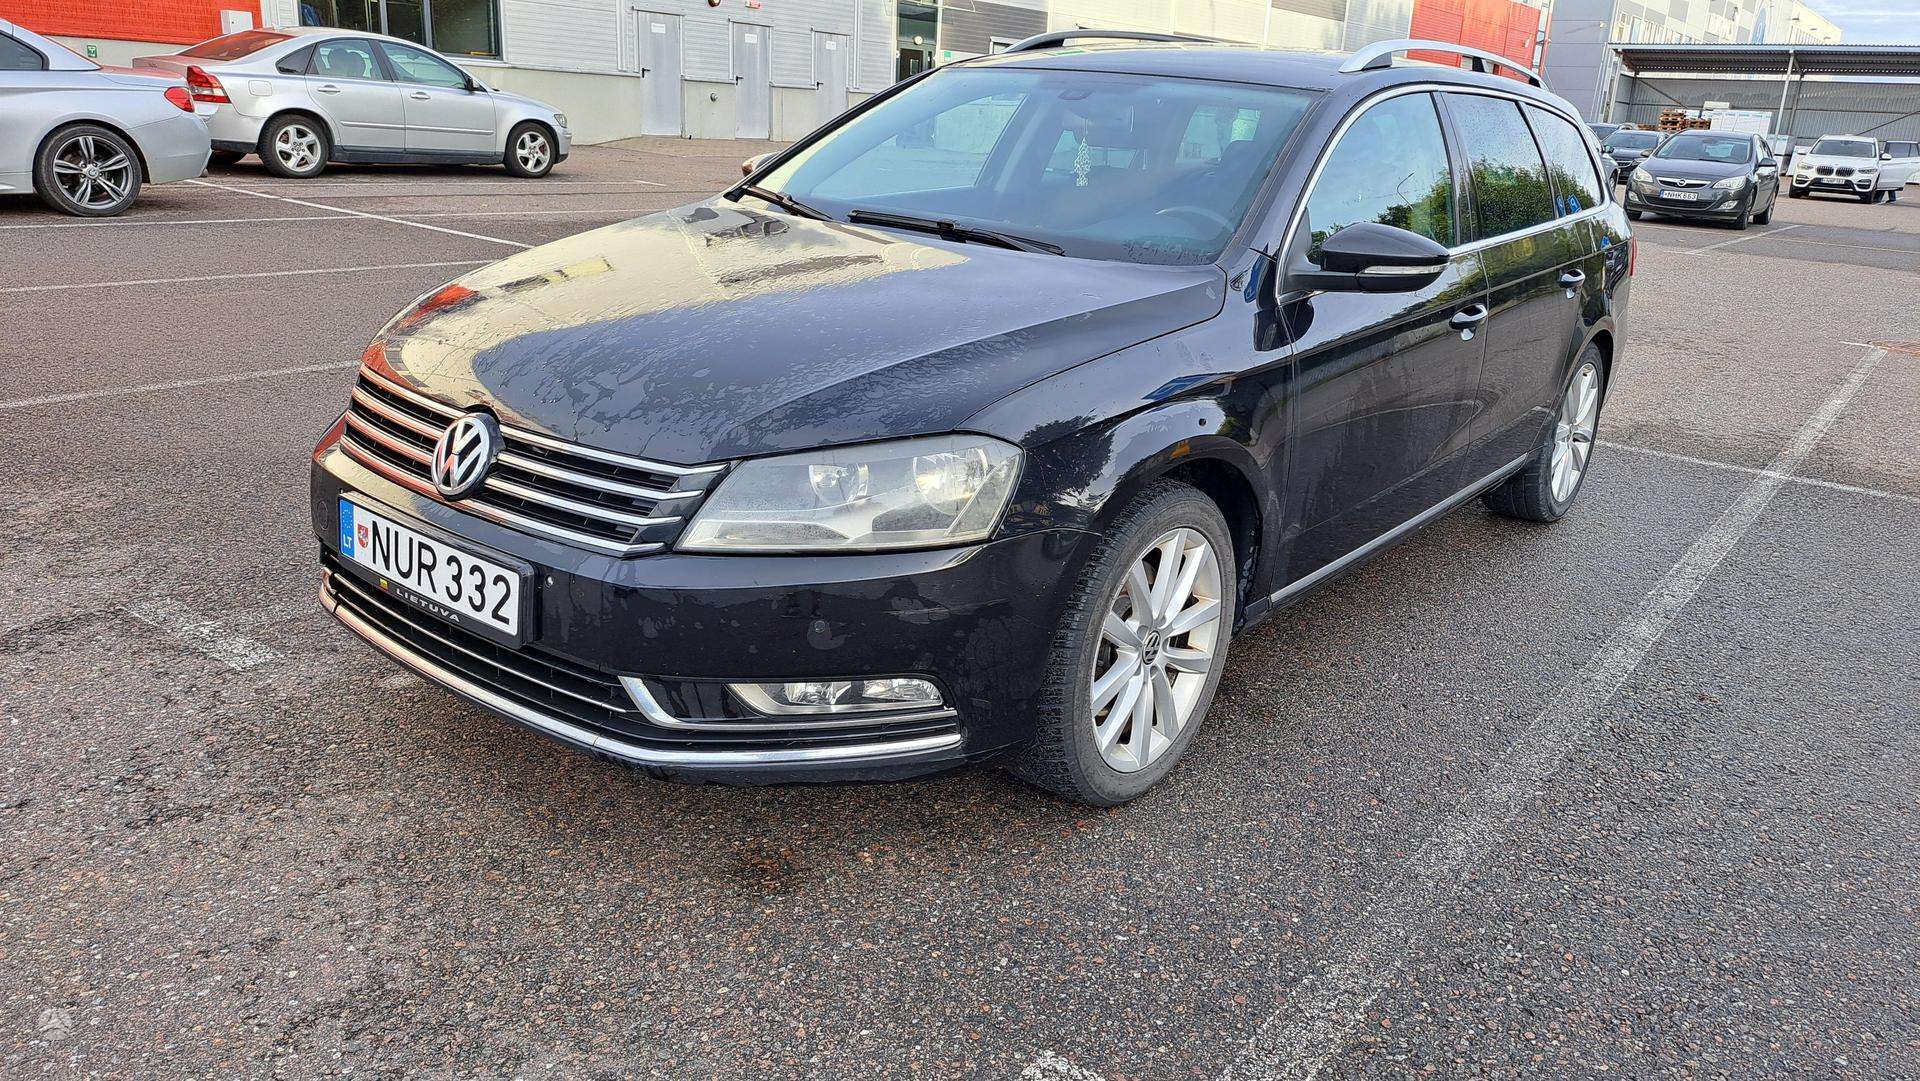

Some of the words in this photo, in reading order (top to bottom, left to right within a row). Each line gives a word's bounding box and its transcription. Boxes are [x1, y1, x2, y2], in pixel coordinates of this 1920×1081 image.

[342, 534, 353, 549] LT
[372, 520, 437, 594] NUR
[445, 554, 511, 625] 332
[395, 587, 460, 623] LIETUVA
